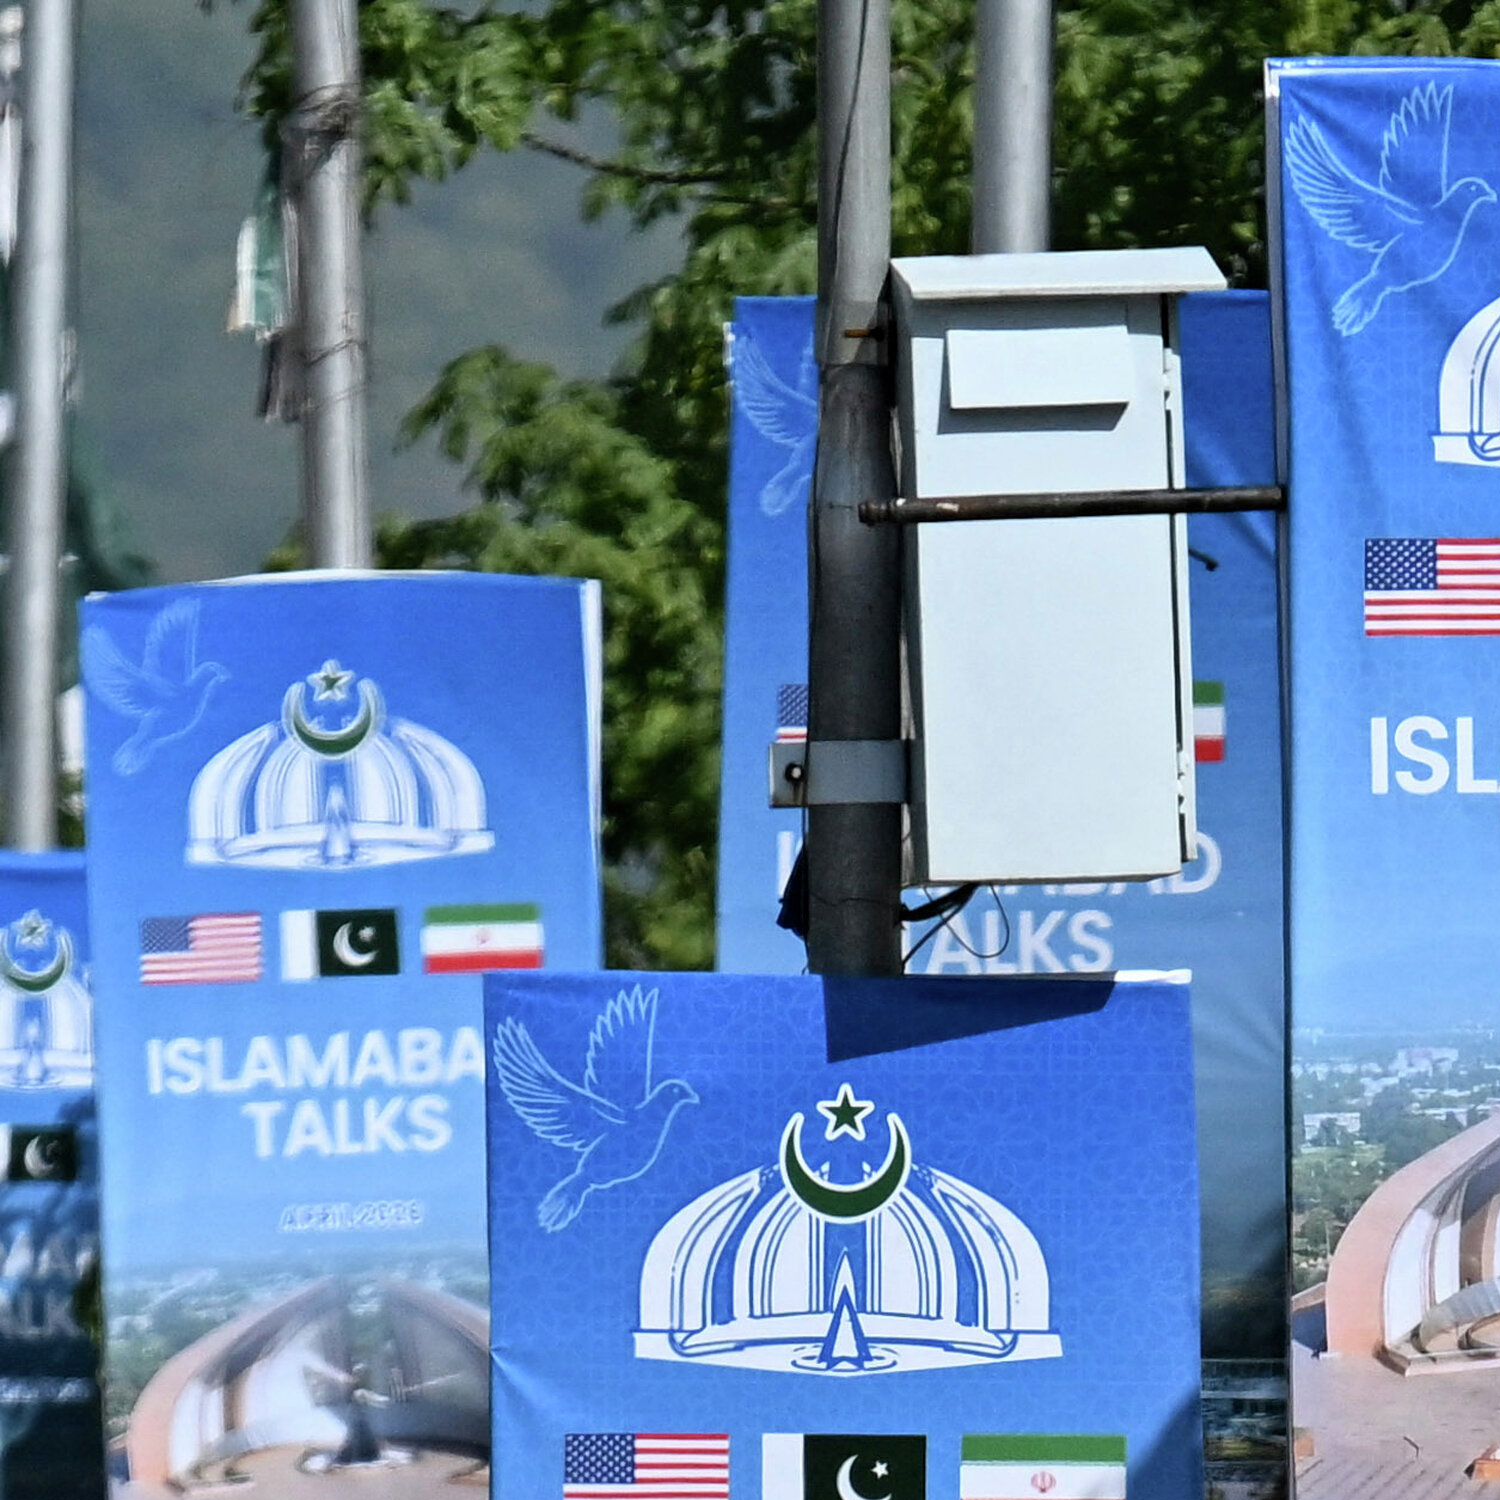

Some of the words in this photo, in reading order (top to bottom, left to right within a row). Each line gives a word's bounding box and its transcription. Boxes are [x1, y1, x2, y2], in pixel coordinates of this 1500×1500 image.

[902, 908, 1115, 974] ALKS
[146, 1026, 484, 1094] ISLAMABA
[242, 1096, 453, 1158] TALKS
